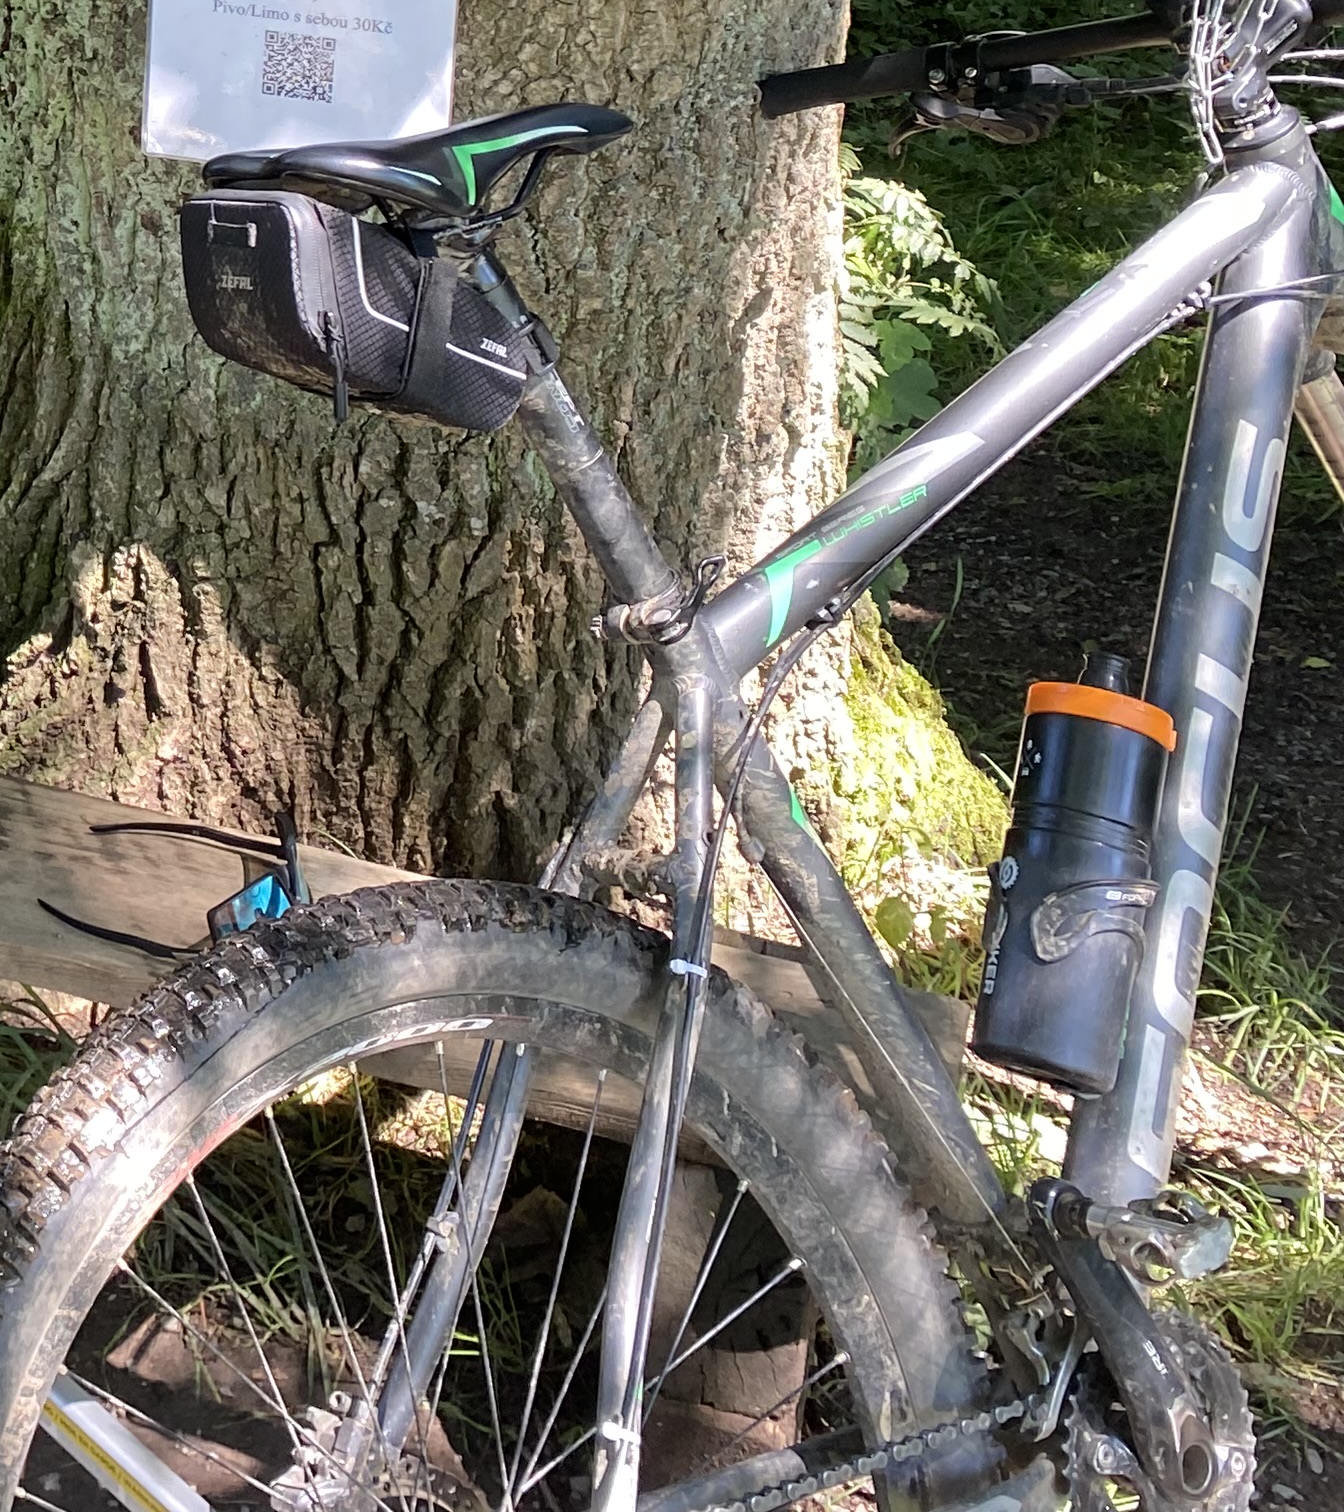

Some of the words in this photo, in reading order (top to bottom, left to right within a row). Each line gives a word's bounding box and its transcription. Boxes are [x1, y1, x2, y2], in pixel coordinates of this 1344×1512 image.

[212, 0, 291, 22] Pivo/Limo
[305, 11, 349, 30] sebou
[353, 16, 394, 35] 30Kč
[821, 483, 928, 546] WHISTLER
